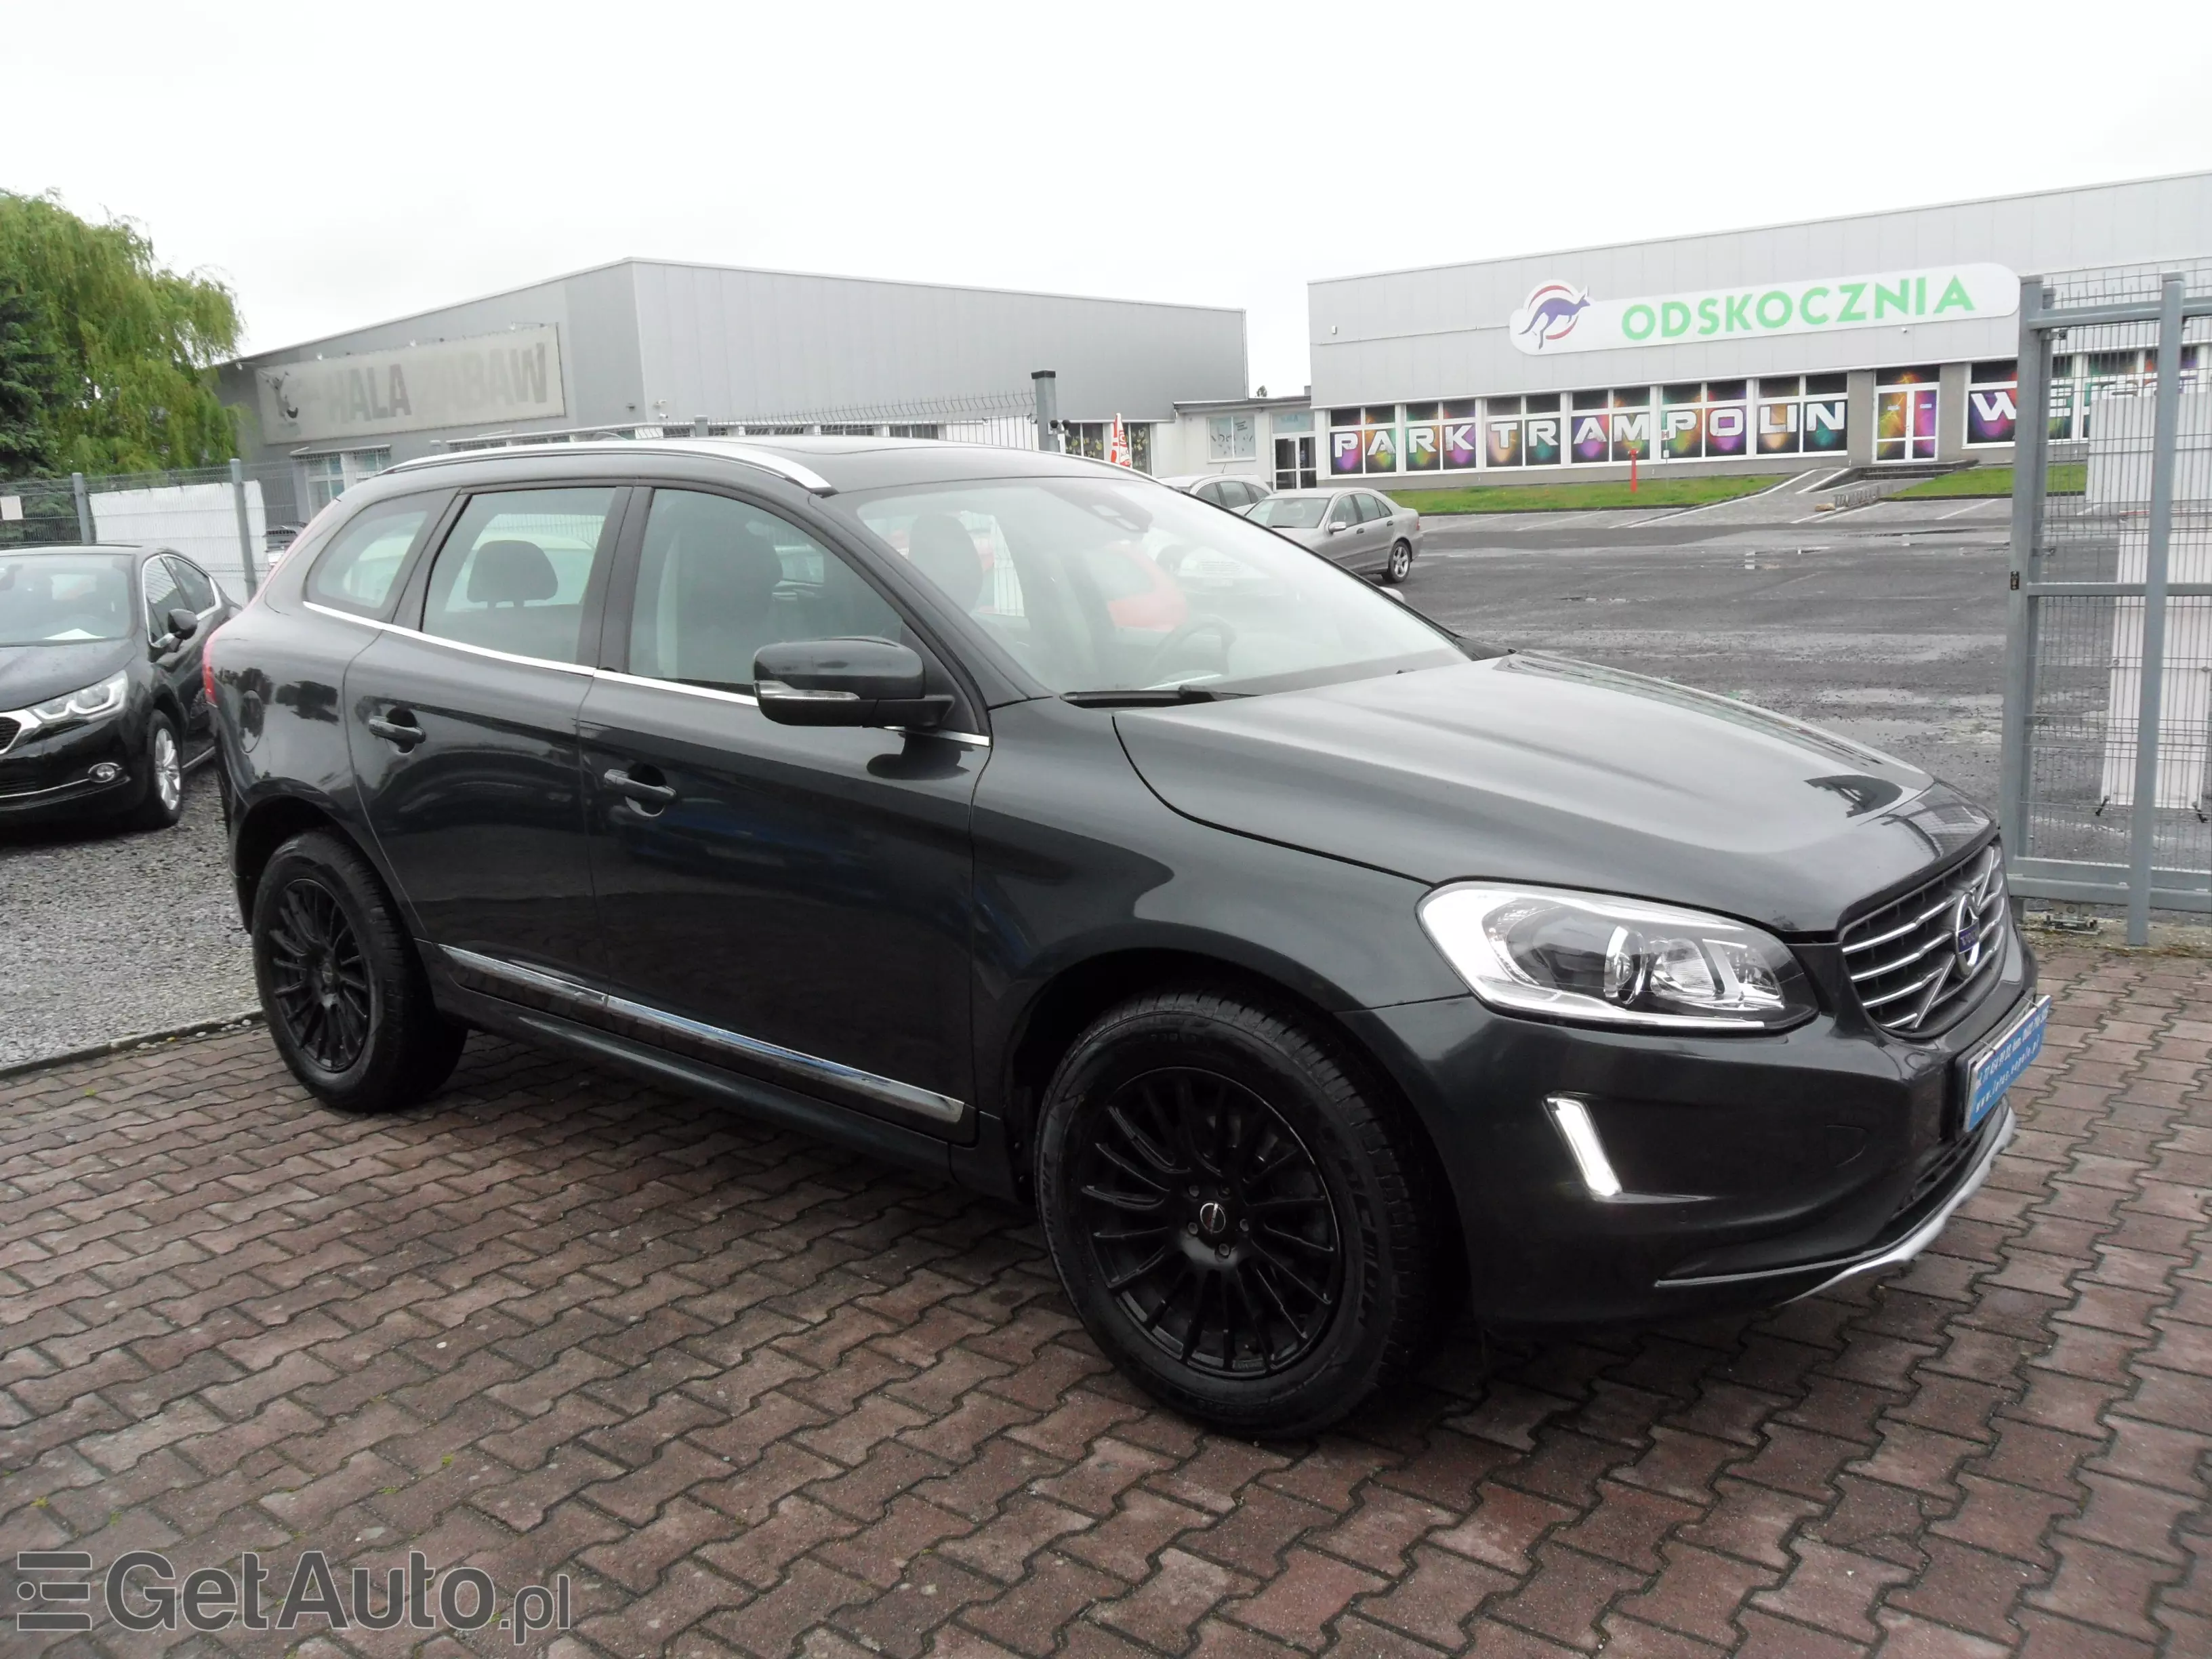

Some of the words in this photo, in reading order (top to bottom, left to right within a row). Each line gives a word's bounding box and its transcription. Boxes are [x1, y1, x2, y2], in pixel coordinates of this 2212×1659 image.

[1621, 274, 1975, 340] ODSKOCZNIA
[1334, 425, 1474, 458] PARK
[1489, 402, 1845, 449] TRAMPOLIN
